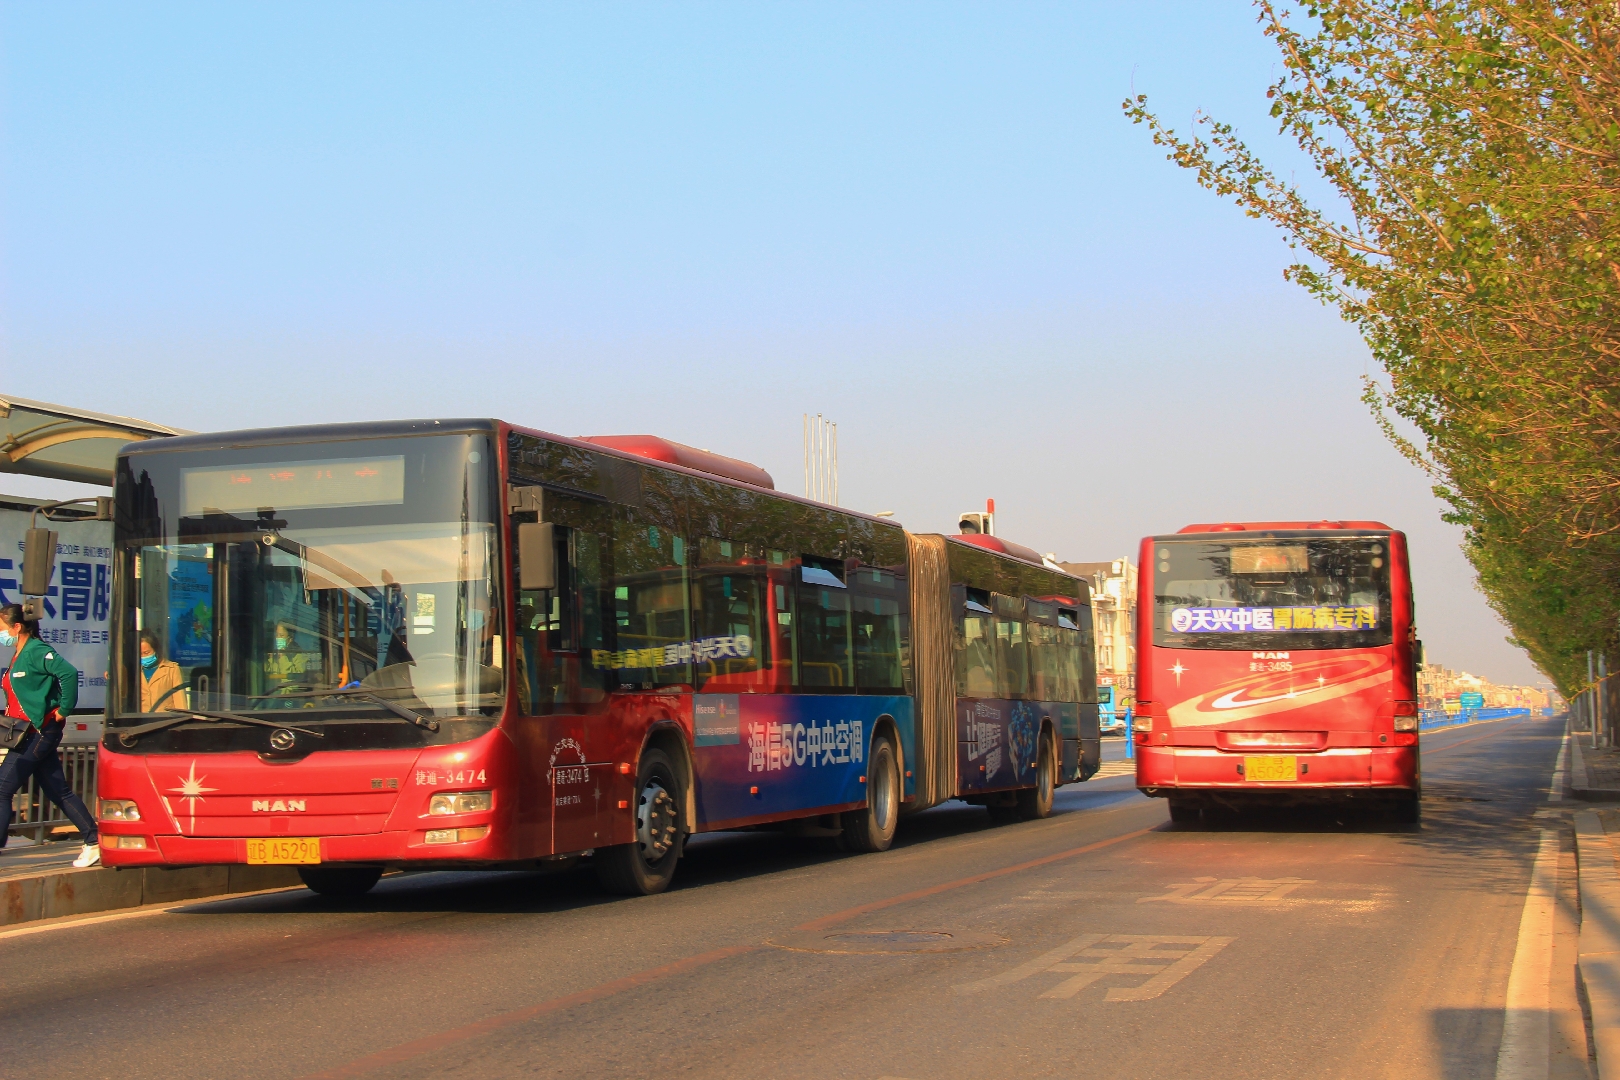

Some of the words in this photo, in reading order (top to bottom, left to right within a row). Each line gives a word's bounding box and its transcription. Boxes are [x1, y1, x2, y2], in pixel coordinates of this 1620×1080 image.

[1191, 606, 1376, 630] 天兴中医胃肠病专科
[40, 628, 69, 644] 生集团
[1252, 652, 1290, 660] MAN
[748, 720, 863, 773] 海信5G中央空调
[415, 768, 487, 786] 捷通-3474
[252, 800, 307, 812] MAN
[272, 842, 318, 860] A5290
